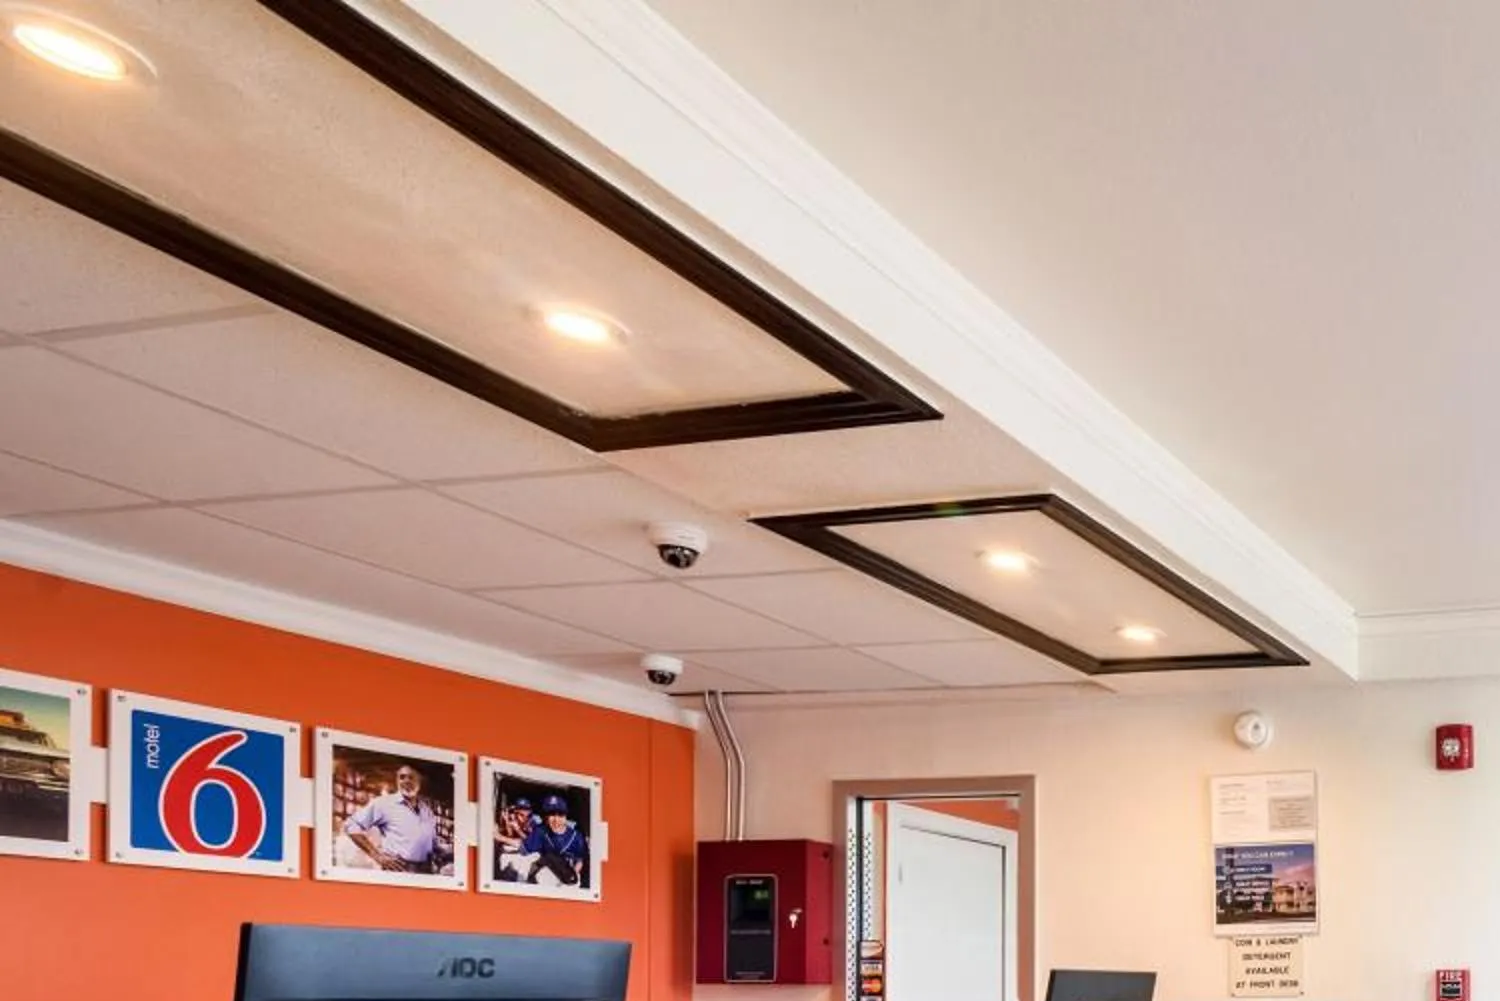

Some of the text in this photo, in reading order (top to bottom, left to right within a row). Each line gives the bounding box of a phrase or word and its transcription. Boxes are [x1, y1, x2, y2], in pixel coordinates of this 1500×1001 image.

[143, 723, 161, 769] motel
[157, 729, 267, 859] 6
[1242, 951, 1291, 961] DETERGENT
[1245, 966, 1290, 975] AVAILABLE
